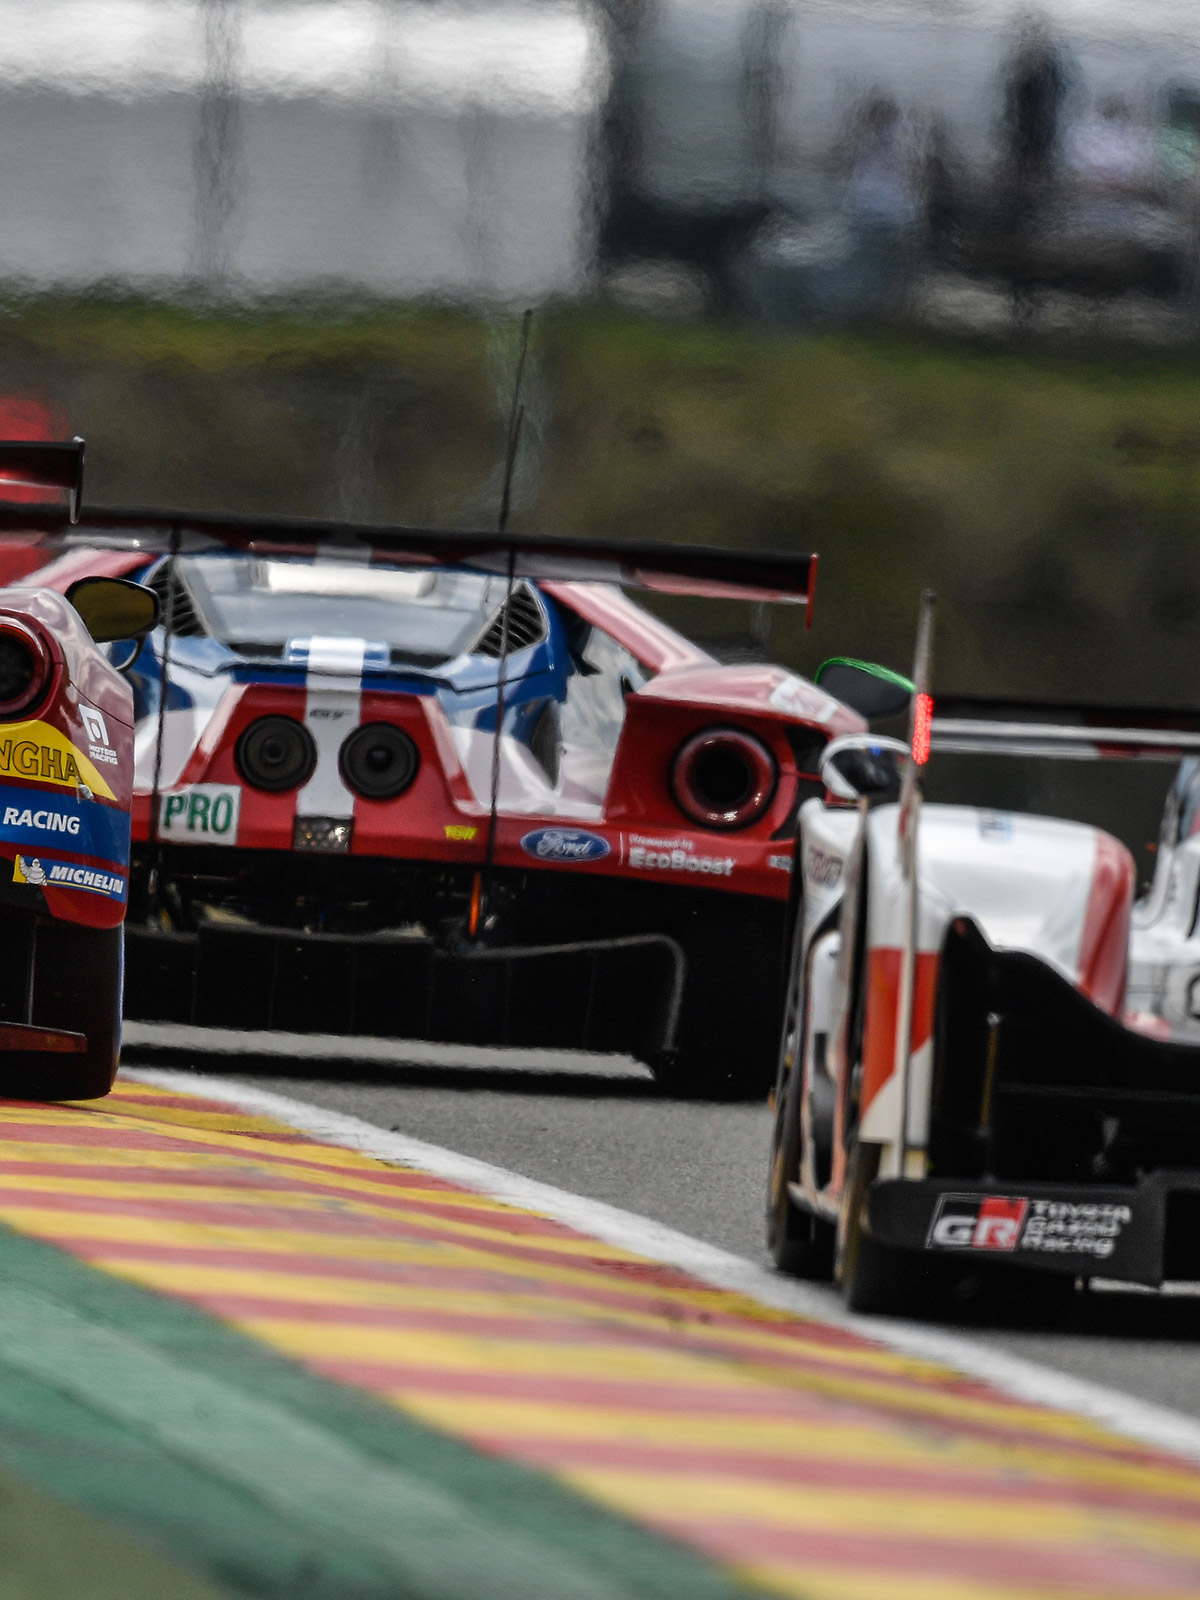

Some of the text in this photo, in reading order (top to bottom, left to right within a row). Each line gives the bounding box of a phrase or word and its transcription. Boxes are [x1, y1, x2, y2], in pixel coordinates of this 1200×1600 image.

[3, 807, 80, 836] RACING
[163, 792, 234, 834] PRO
[536, 830, 593, 857] Ford
[629, 847, 736, 877] EcoBoost
[49, 865, 125, 894] MICHELIN
[933, 1215, 1018, 1248] GR
